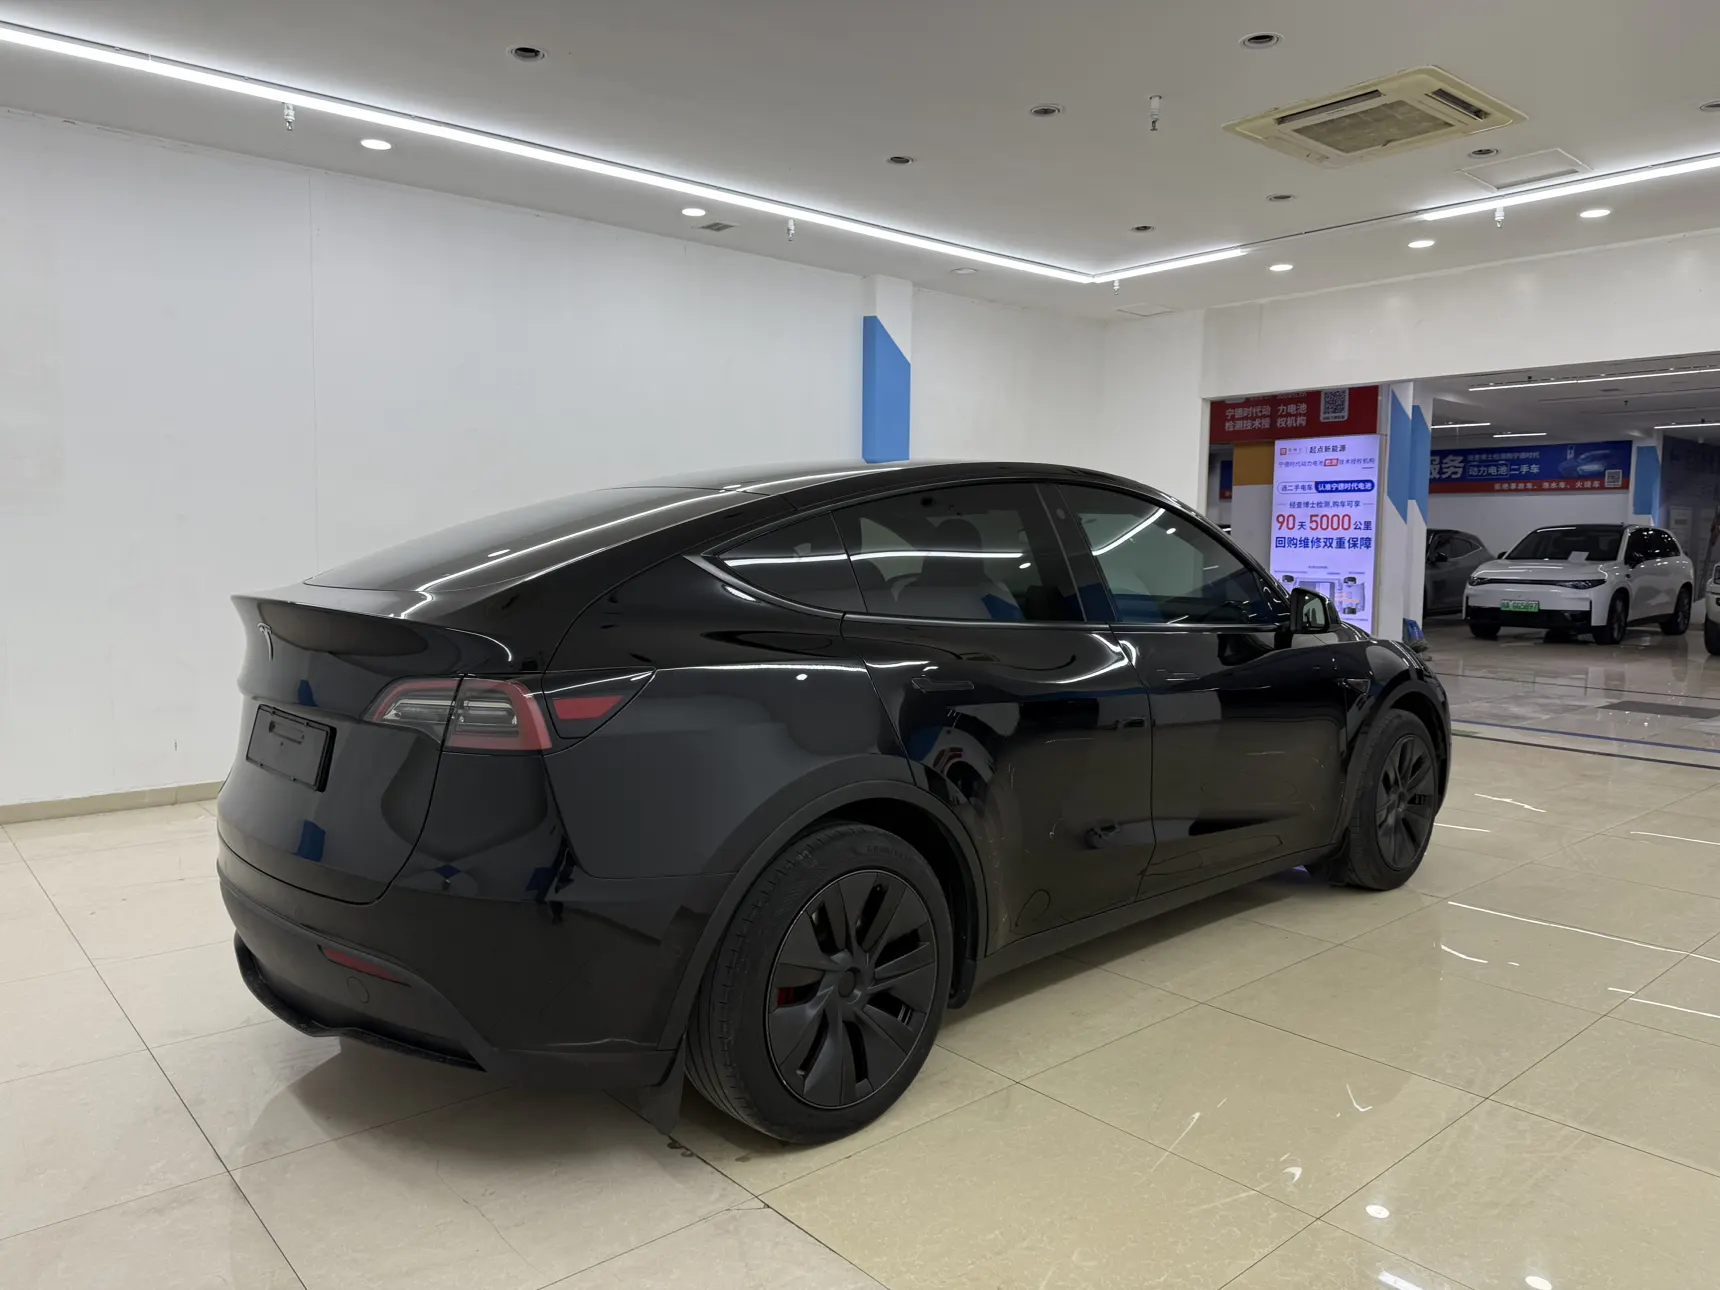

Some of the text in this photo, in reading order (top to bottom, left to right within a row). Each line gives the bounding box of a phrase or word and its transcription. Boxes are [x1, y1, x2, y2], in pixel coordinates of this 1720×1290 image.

[1225, 403, 1307, 419] 宁德时代动 力电池
[1225, 417, 1270, 431] 检测技术授
[1276, 415, 1306, 428] 权机构
[1309, 445, 1346, 454] 起点新能源
[1468, 464, 1540, 476] 动力电池 二手车
[1281, 482, 1373, 492] 选二手电车 认准宁德时代电池
[1275, 537, 1372, 549] 回购维修双重保障
